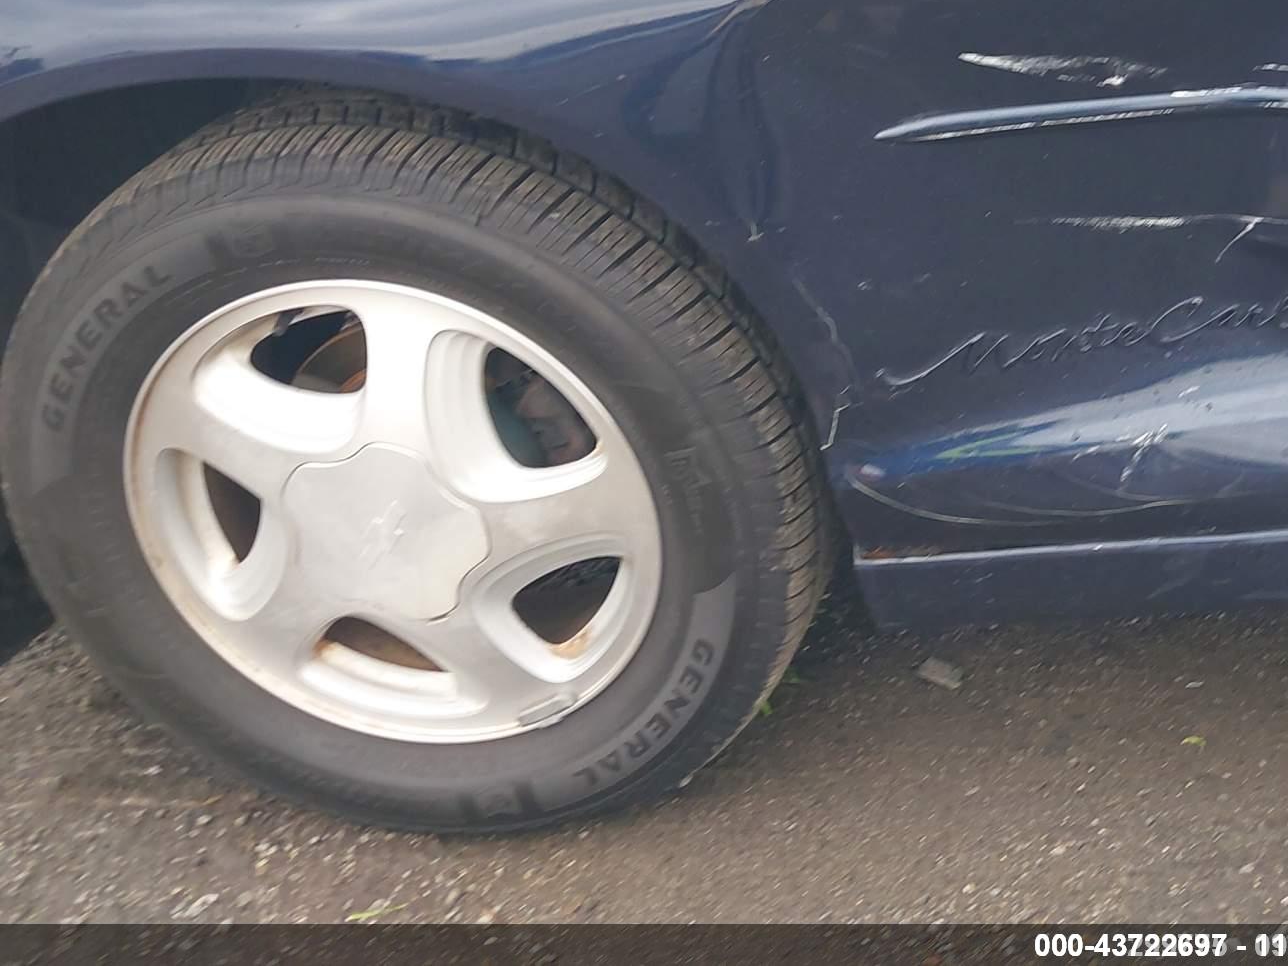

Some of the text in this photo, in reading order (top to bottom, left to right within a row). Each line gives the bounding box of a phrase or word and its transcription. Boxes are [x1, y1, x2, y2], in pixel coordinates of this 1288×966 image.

[41, 265, 172, 432] GENERAL
[876, 312, 1141, 387] Monte
[572, 637, 716, 786] GENERAL
